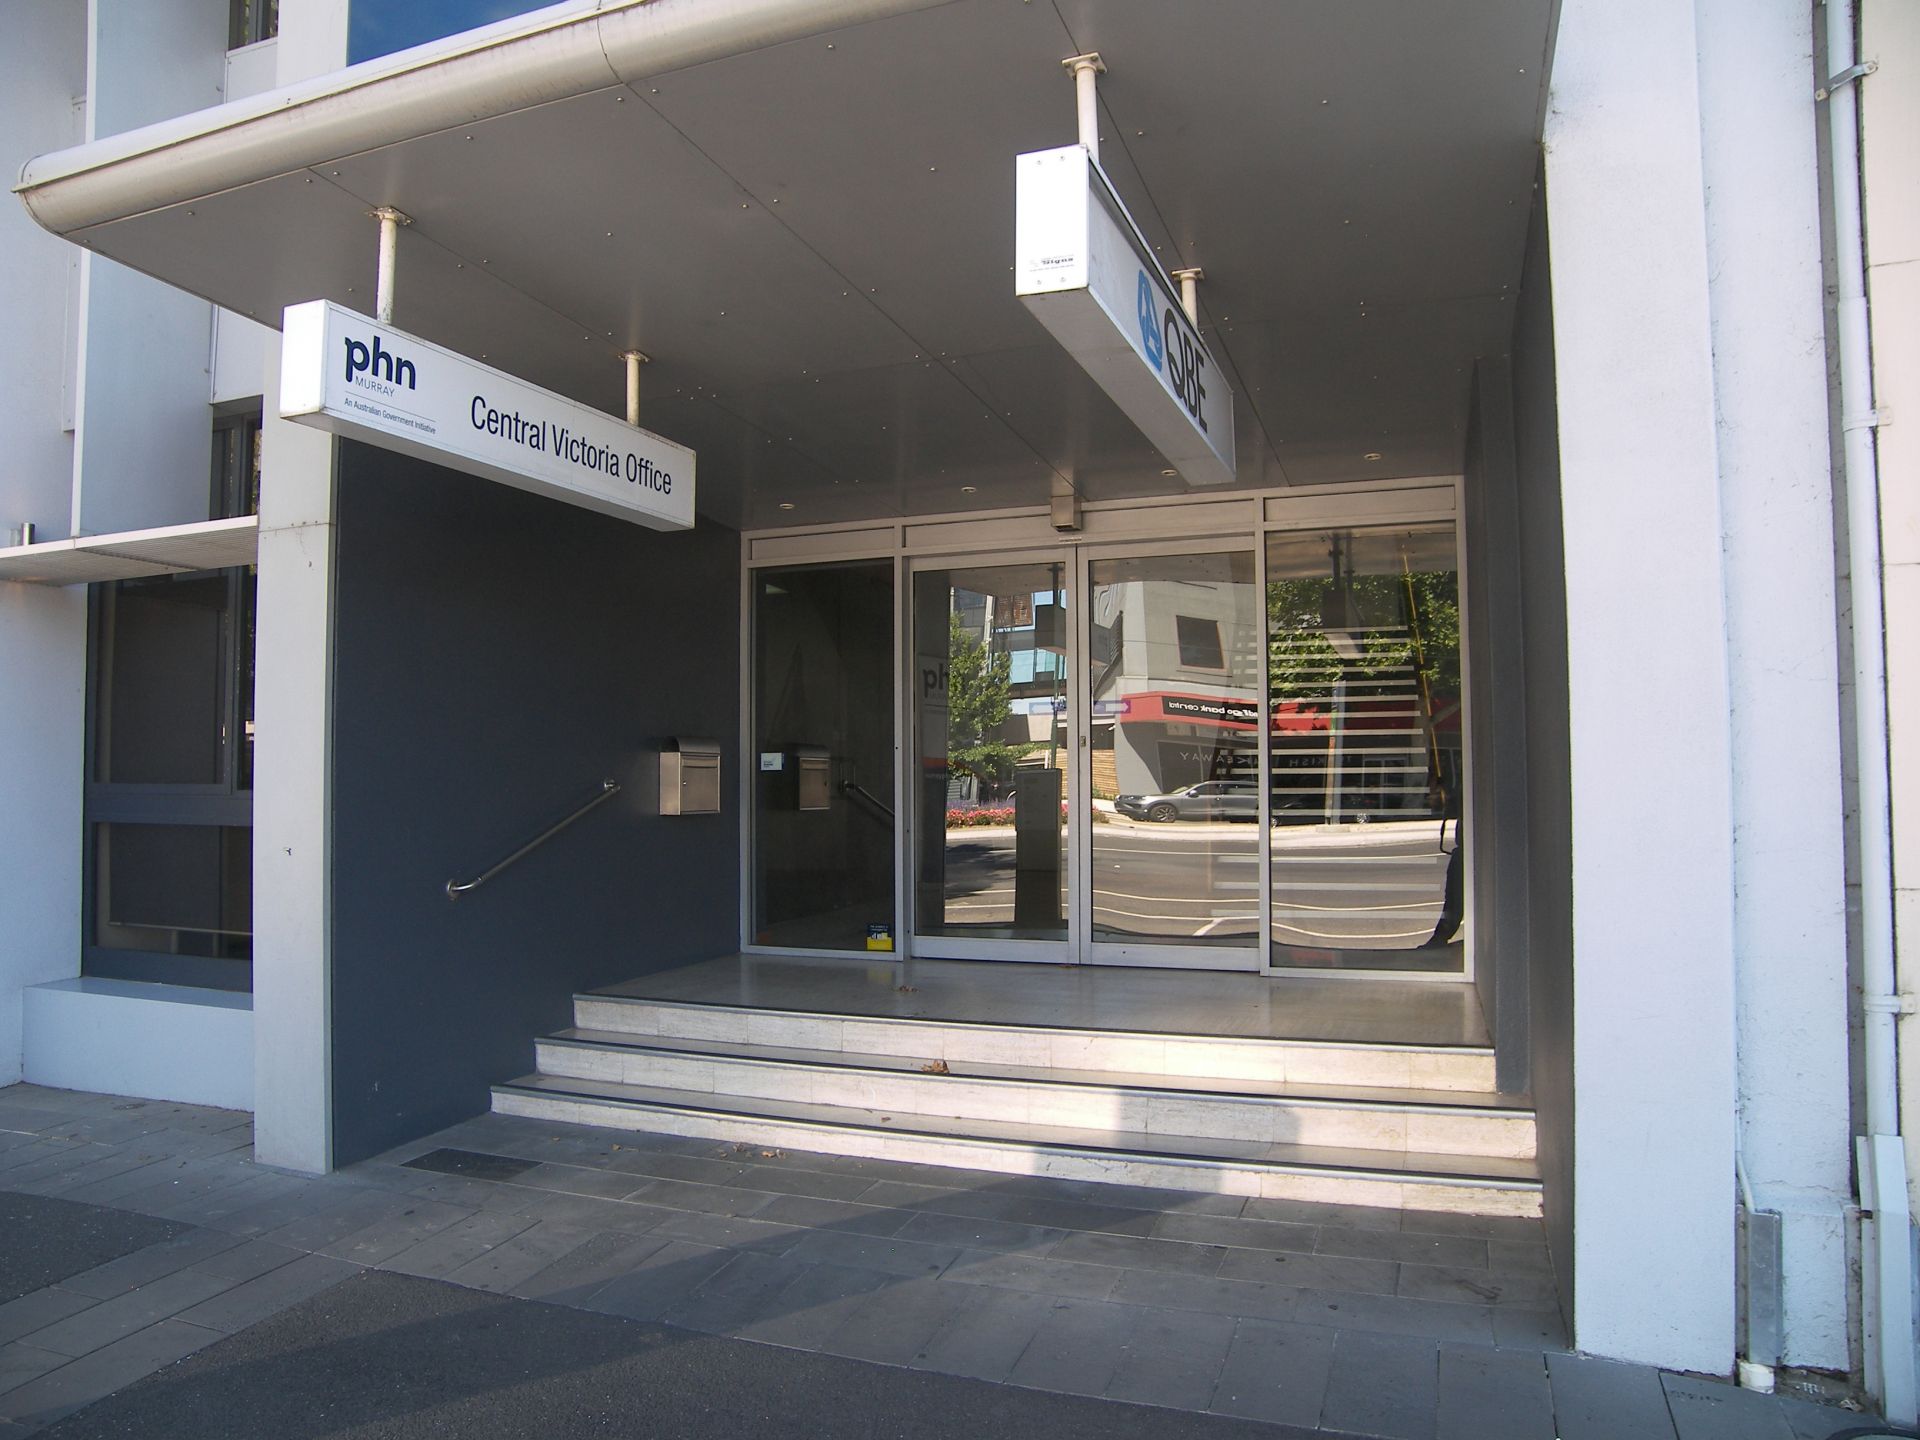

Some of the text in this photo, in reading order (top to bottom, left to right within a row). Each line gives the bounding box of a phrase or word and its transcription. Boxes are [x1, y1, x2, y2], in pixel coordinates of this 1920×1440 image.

[344, 335, 416, 390] phn
[355, 375, 395, 397] MURRAY
[1164, 307, 1208, 433] QBE
[344, 397, 436, 434] An Australian Government Initiative
[471, 395, 671, 495] Central Victoria Office
